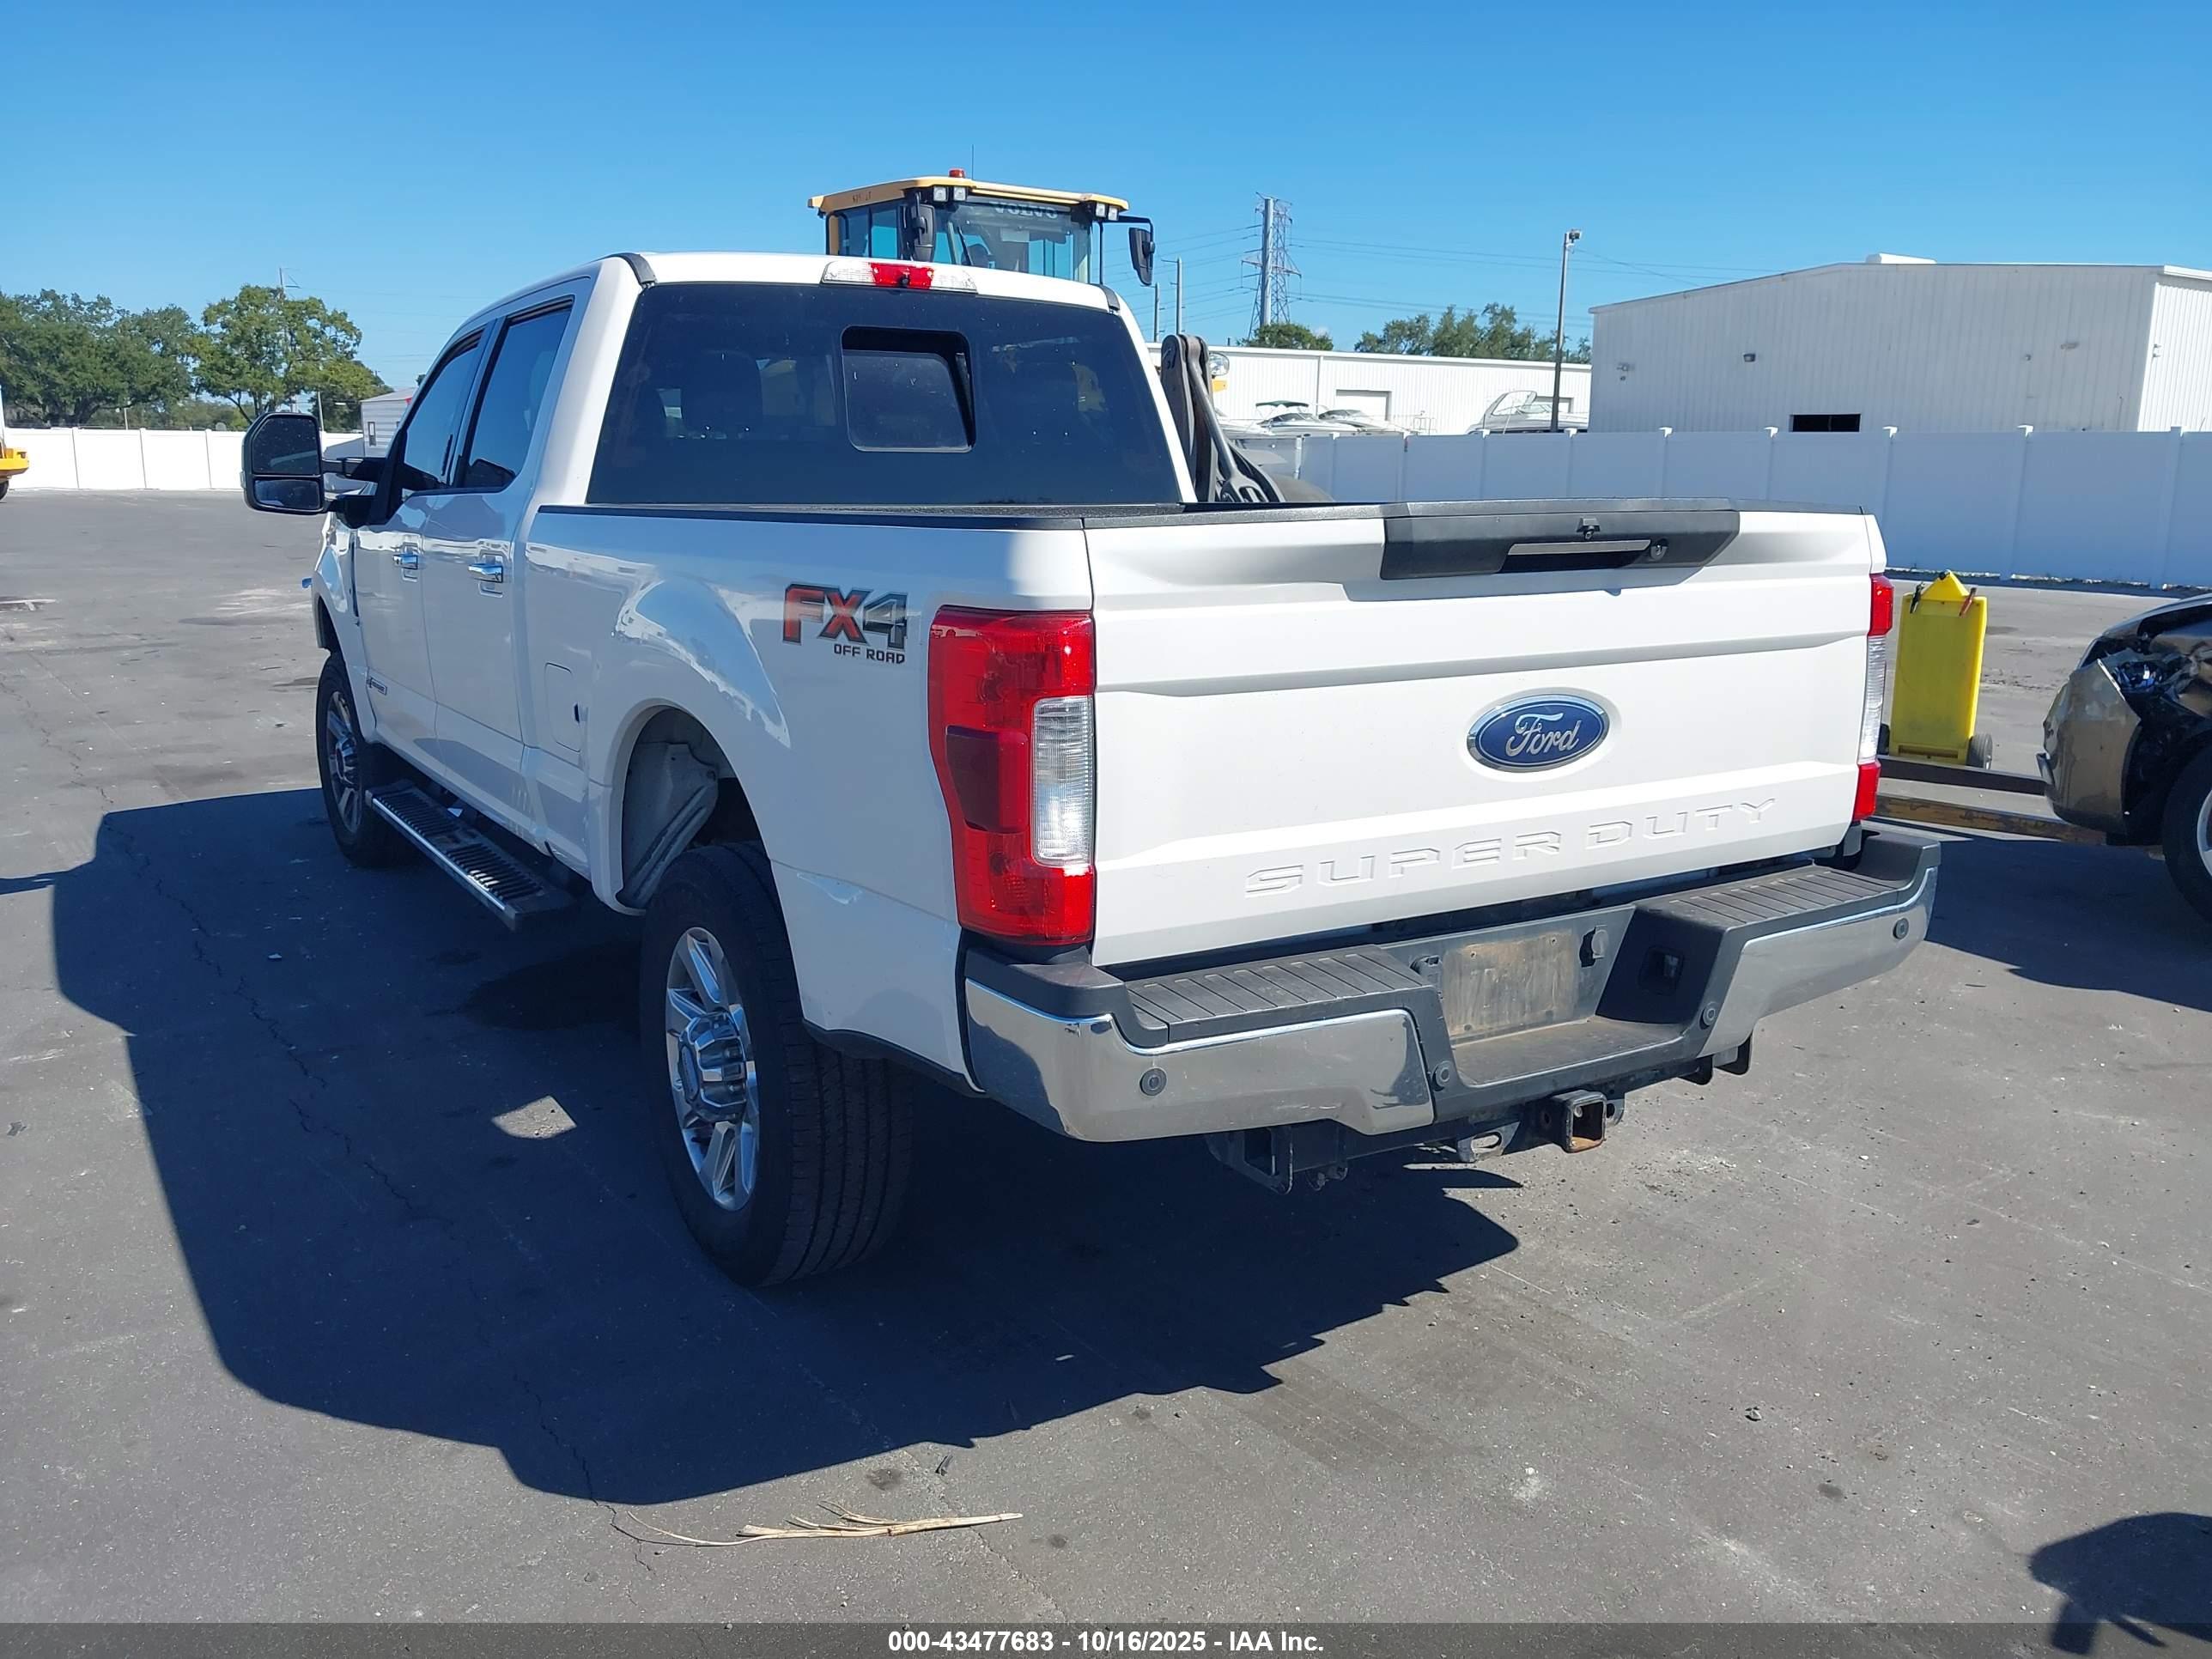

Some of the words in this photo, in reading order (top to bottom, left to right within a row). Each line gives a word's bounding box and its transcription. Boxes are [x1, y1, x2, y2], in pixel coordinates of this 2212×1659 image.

[988, 201, 1059, 219] VOLVO
[782, 582, 908, 650] FX4
[834, 644, 861, 658] OFF
[866, 650, 906, 665] ROAD
[1504, 712, 1581, 757] Ford
[1245, 830, 1561, 898] SUPER
[1585, 798, 1777, 850] DUTY
